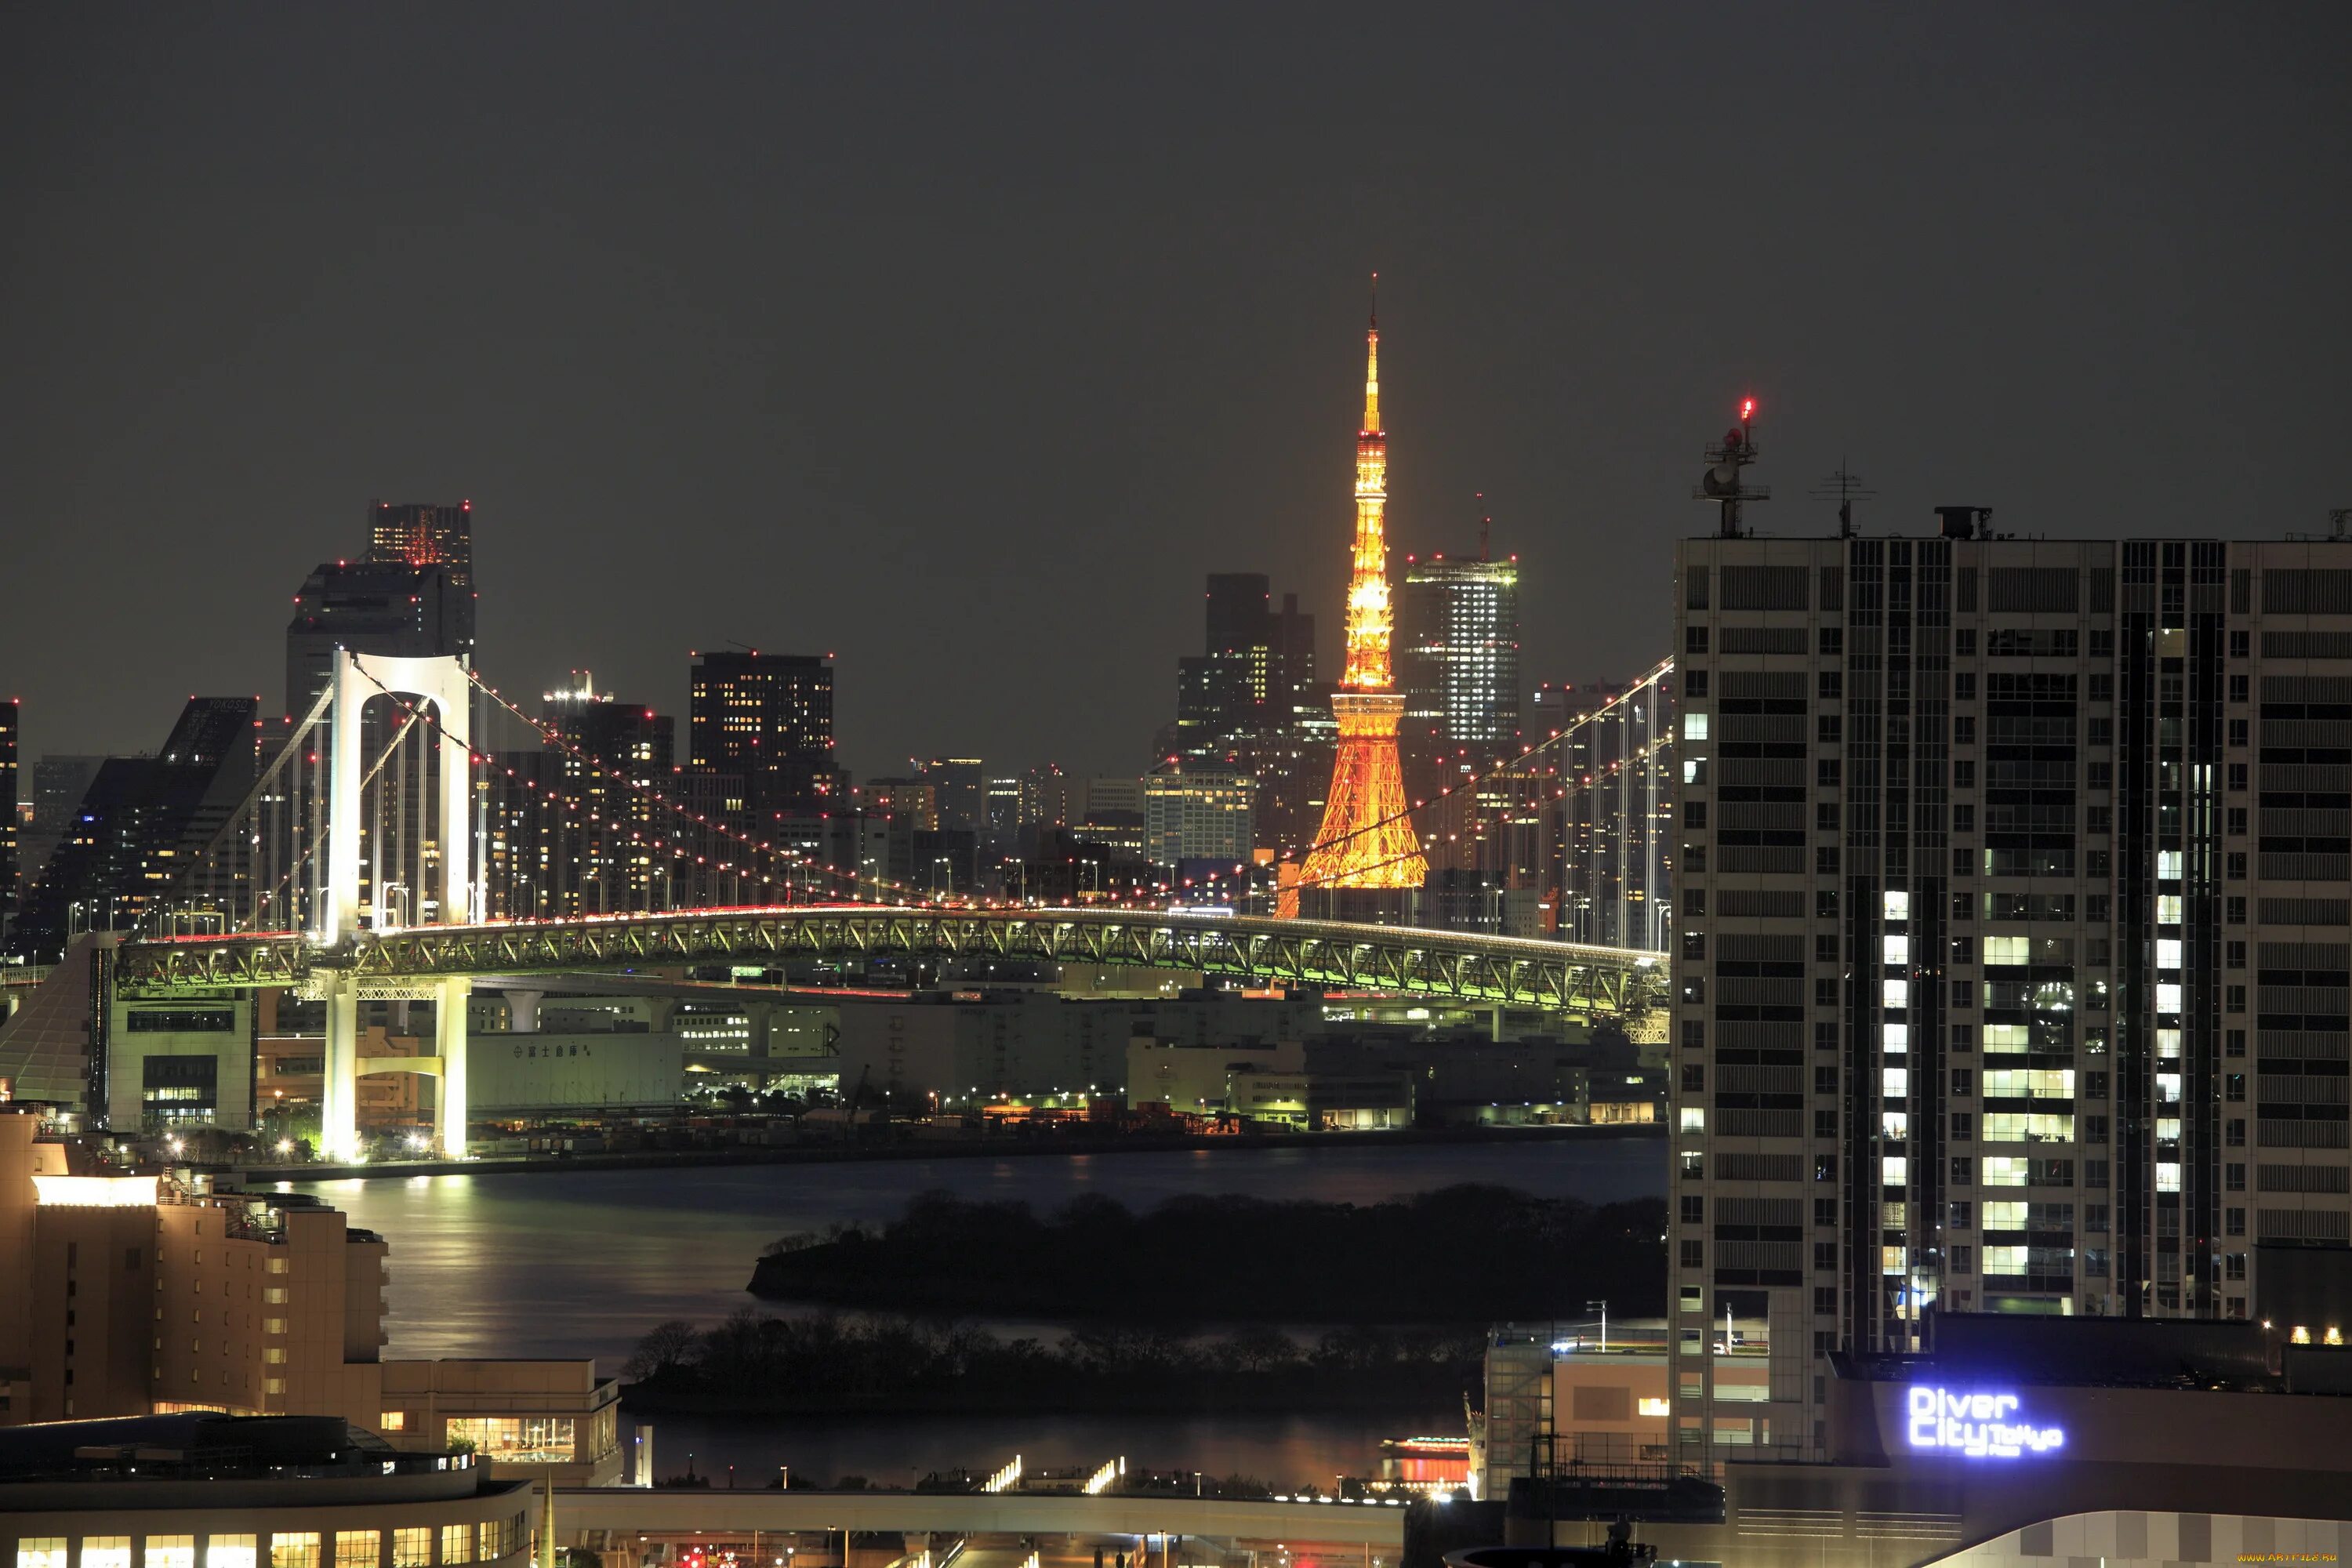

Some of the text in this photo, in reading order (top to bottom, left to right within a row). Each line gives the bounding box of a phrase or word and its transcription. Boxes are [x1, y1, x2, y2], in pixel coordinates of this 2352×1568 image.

[1909, 1387, 2018, 1419] Diver
[1909, 1416, 2063, 1456] City Tokyo
